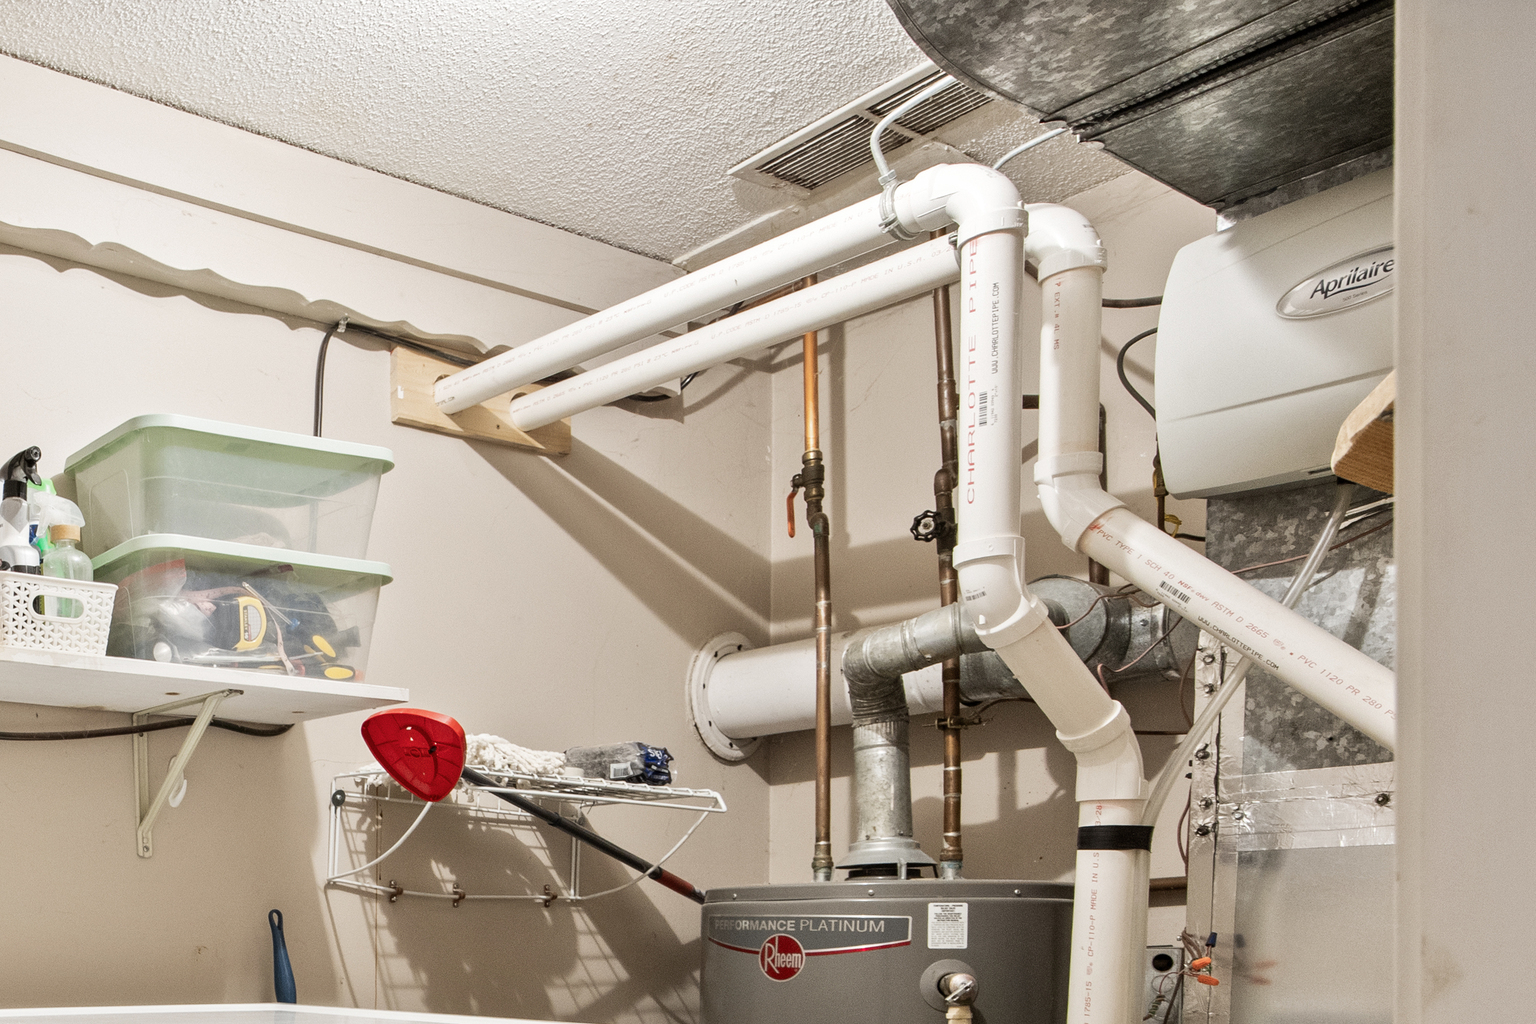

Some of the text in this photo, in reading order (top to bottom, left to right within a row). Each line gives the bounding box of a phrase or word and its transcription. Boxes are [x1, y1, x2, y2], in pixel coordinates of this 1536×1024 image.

[1309, 259, 1395, 300] Aprilaire
[966, 237, 978, 504] CHARLOTTE PIPE
[1097, 529, 1113, 542] PVC
[1116, 540, 1134, 555] TYPE
[1145, 559, 1162, 571] SCH
[1164, 570, 1175, 580] 40
[1212, 601, 1234, 617] ASTM
[1245, 623, 1269, 639] 2665
[1298, 655, 1317, 669] PVC
[1320, 669, 1344, 685] 1120
[1346, 685, 1360, 696] PR
[1363, 696, 1383, 710] 280
[1197, 616, 1279, 671] WWW.CHARLOTTEPIPE.COM
[1091, 873, 1098, 883] IN
[1090, 889, 1098, 910] MADE
[714, 919, 885, 933] PERFORMANCE PLATINUM
[765, 935, 802, 974] Rheem
